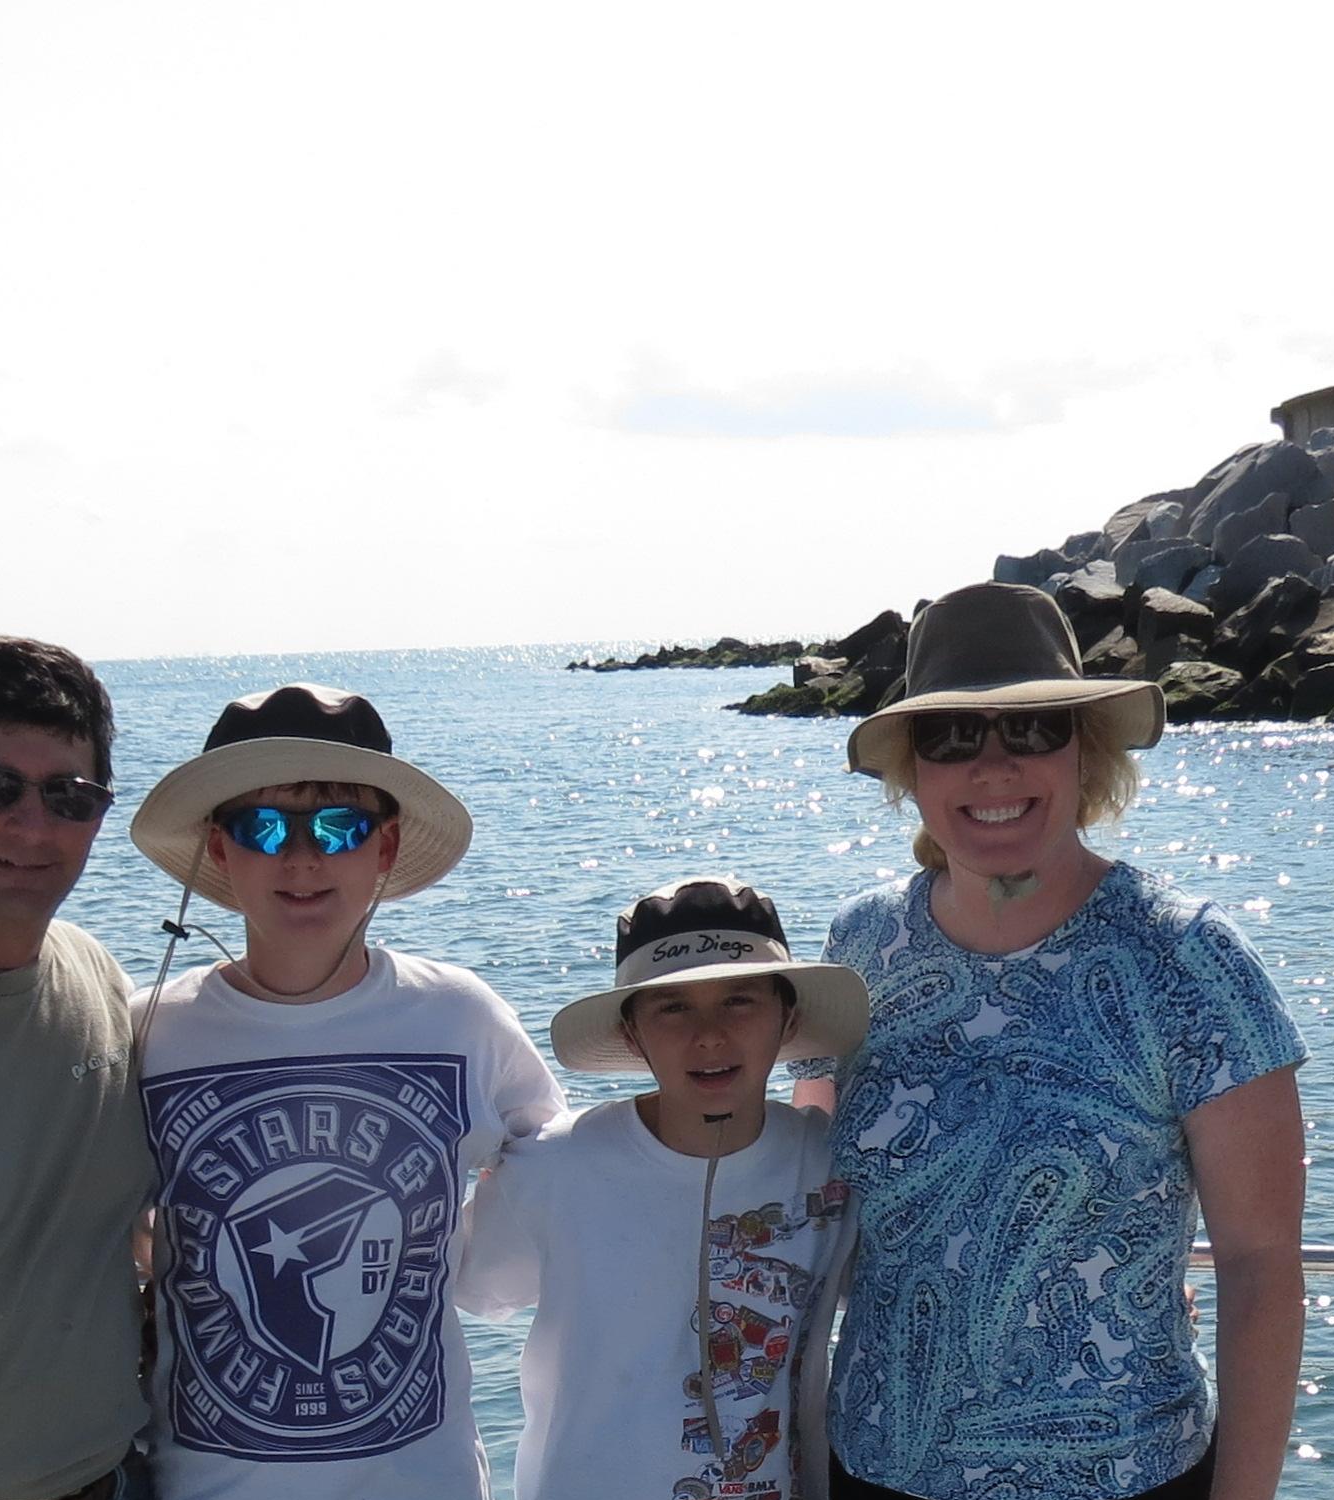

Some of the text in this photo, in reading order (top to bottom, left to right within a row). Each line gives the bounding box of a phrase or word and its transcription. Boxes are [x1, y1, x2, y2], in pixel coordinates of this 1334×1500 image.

[652, 934, 754, 962] San Diego
[166, 1083, 439, 1151] DOING OUR
[187, 1101, 391, 1200] STARS
[331, 1194, 446, 1414] STRAPS
[362, 1239, 395, 1264] DT
[362, 1269, 391, 1295] DT
[186, 1368, 430, 1427] OWN THING
[295, 1382, 326, 1396] SINCE
[295, 1402, 328, 1416] 1999
[748, 1480, 777, 1491] BMX
